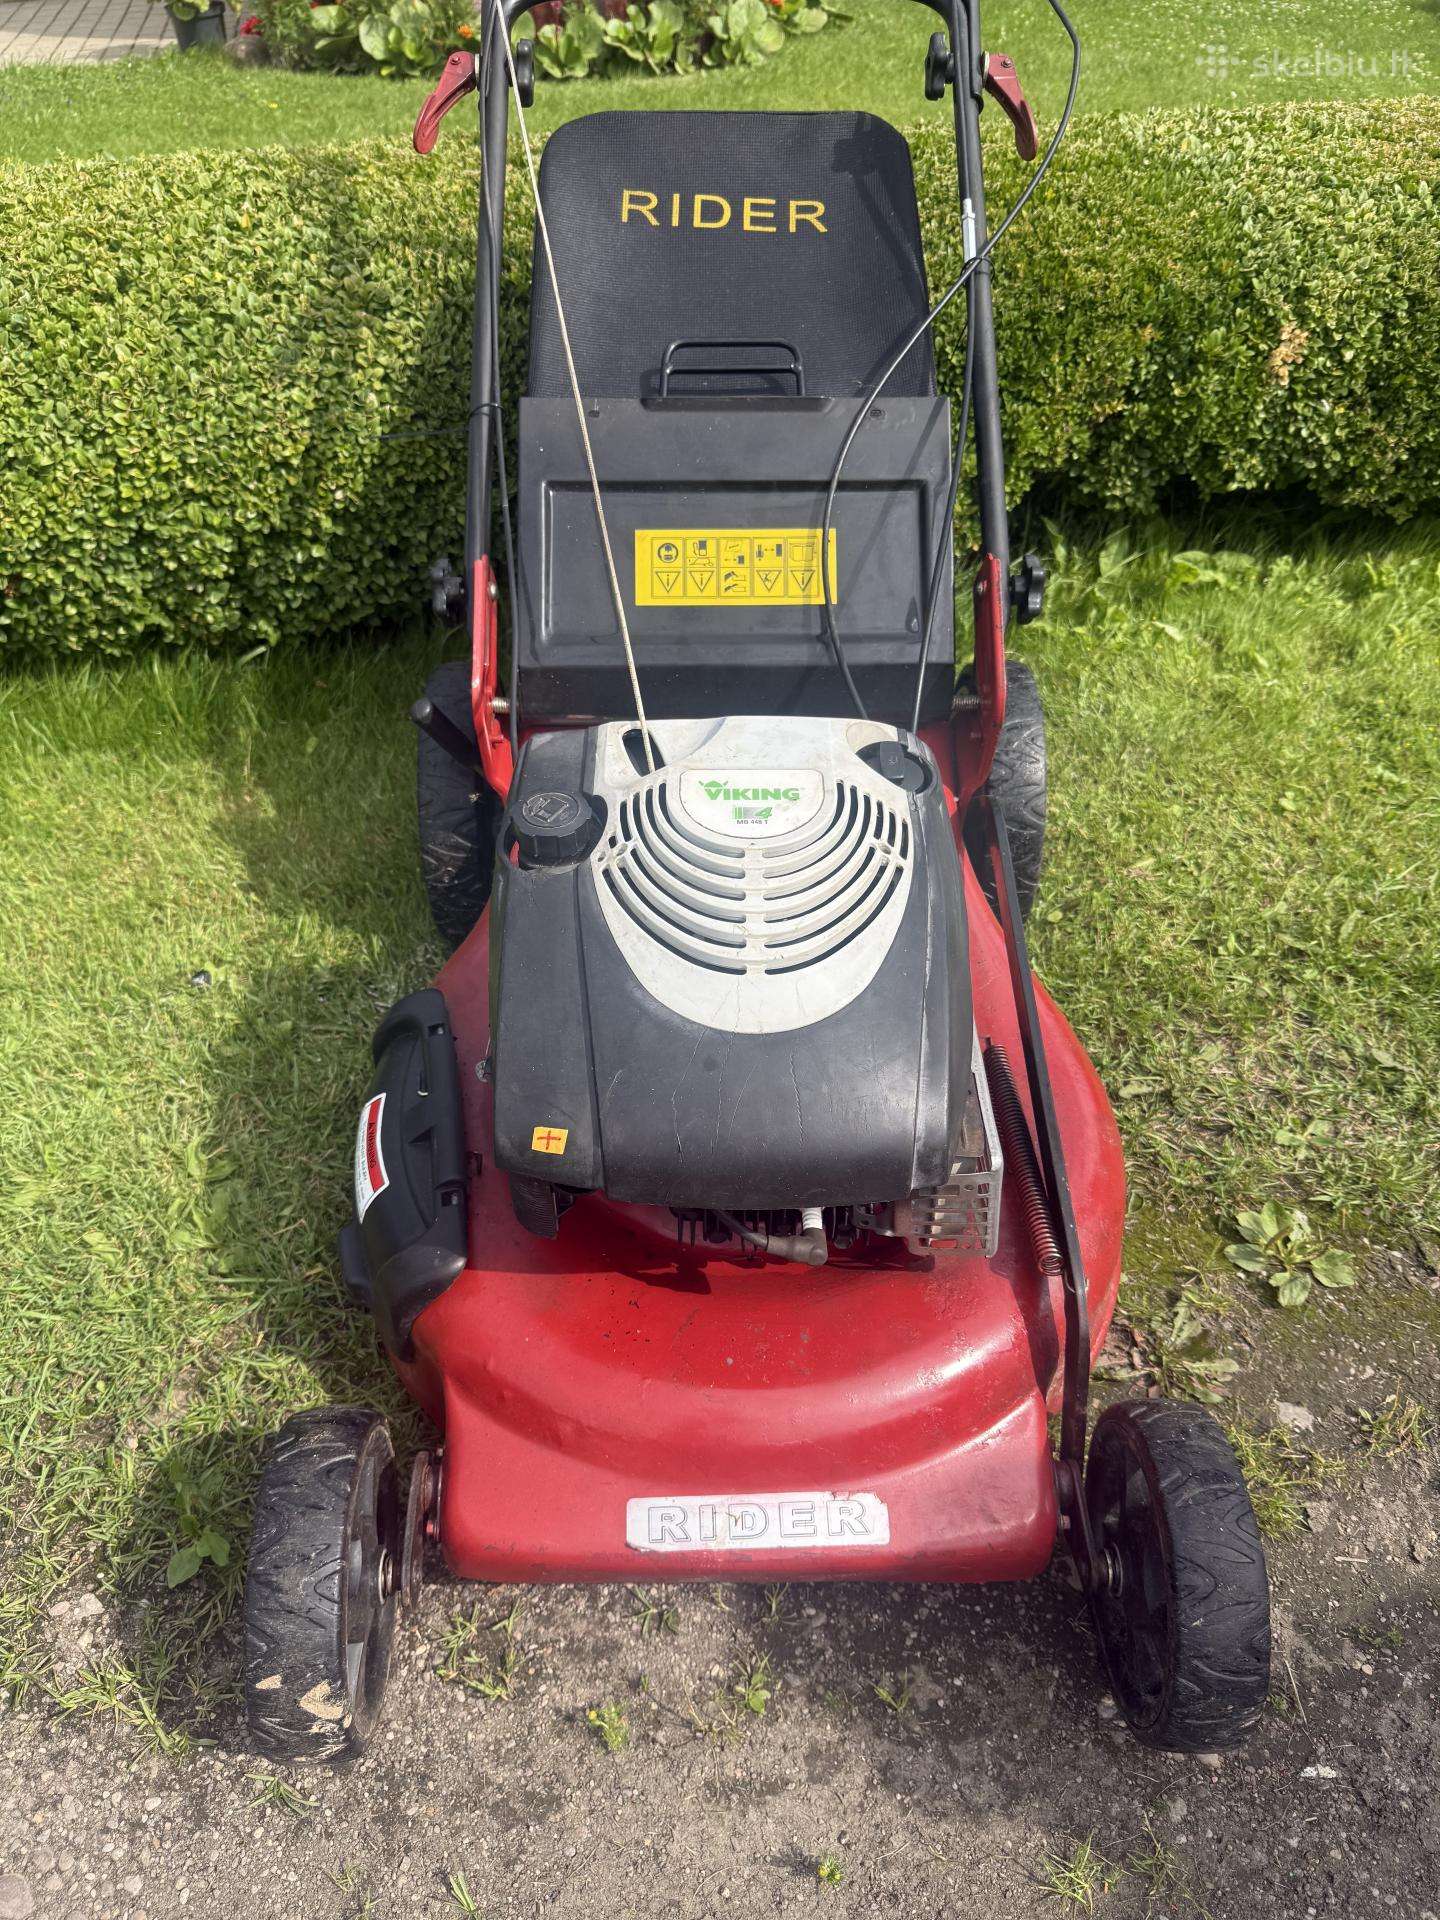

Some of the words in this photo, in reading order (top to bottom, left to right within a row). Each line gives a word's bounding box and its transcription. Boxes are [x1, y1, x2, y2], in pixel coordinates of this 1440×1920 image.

[621, 189, 828, 233] RIDER
[702, 785, 801, 801] VIKING
[647, 1499, 872, 1544] RIDER
